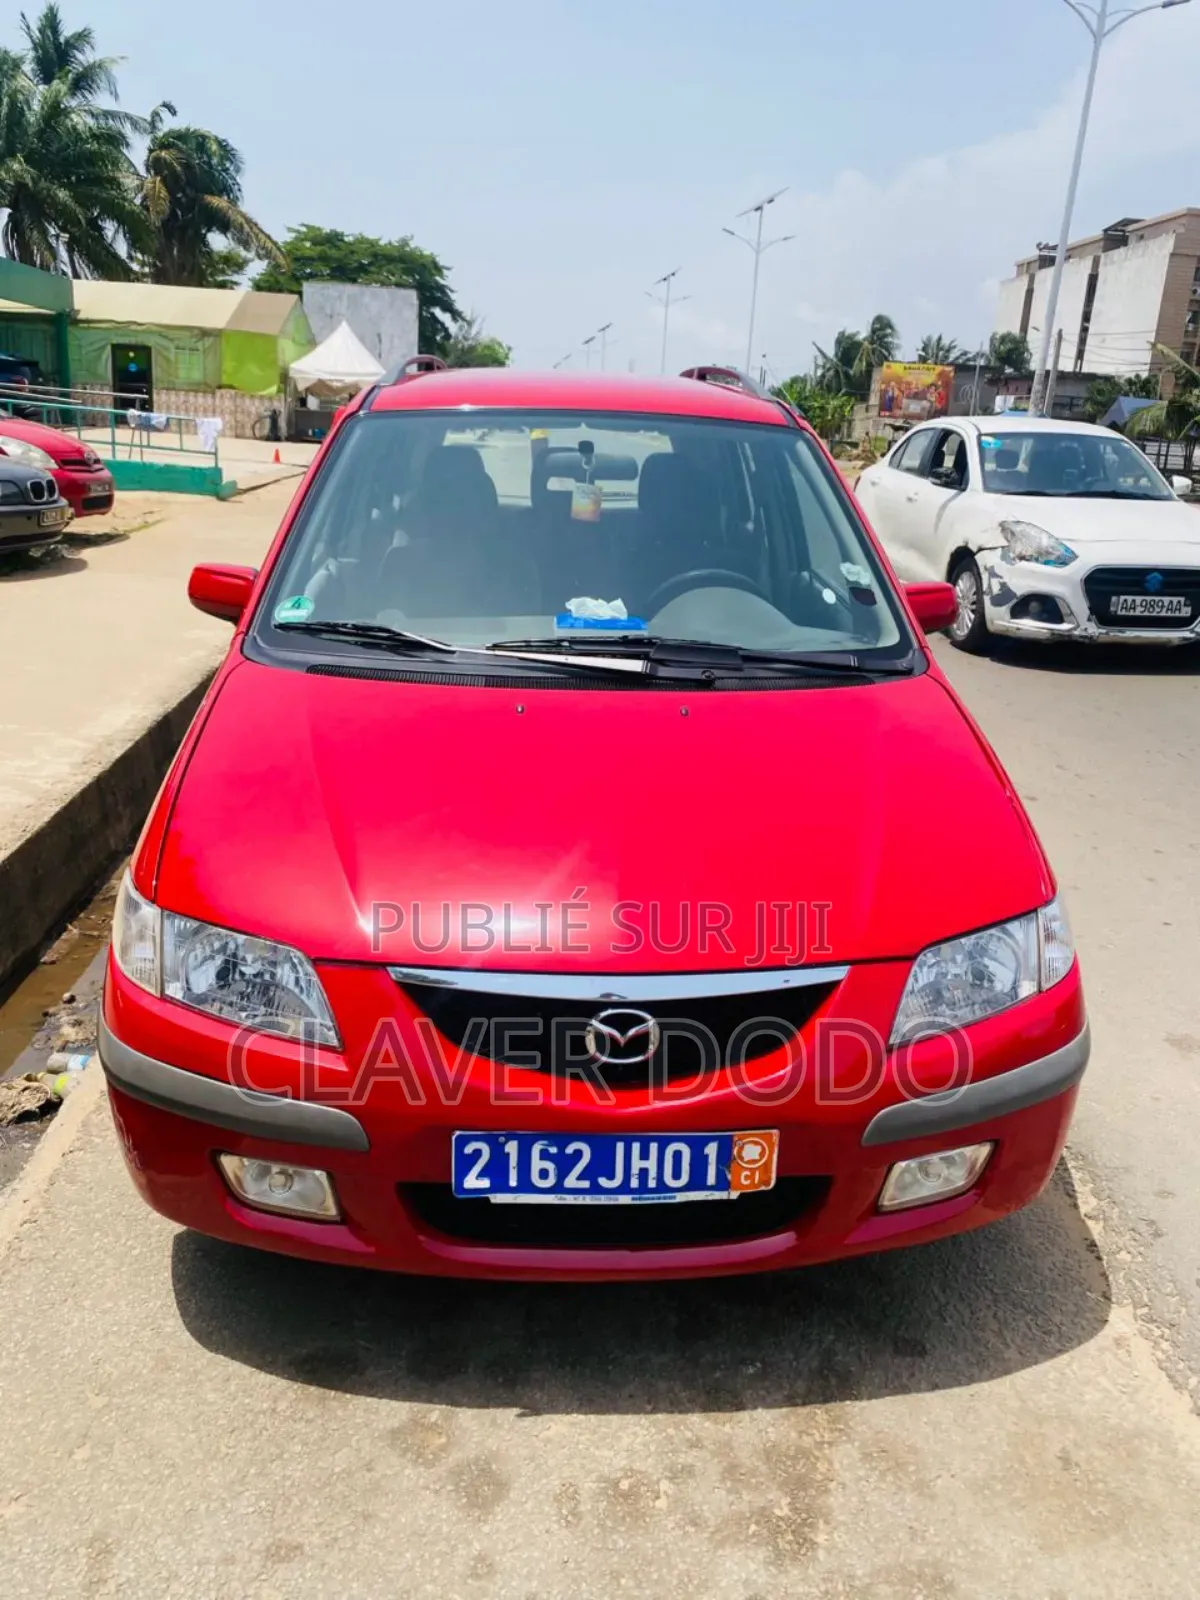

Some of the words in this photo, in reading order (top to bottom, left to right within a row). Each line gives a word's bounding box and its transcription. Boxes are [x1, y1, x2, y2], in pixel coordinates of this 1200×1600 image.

[1119, 598, 1182, 614] AA-989-AA
[463, 1139, 718, 1189] 2162JH01
[740, 1171, 760, 1186] CI
